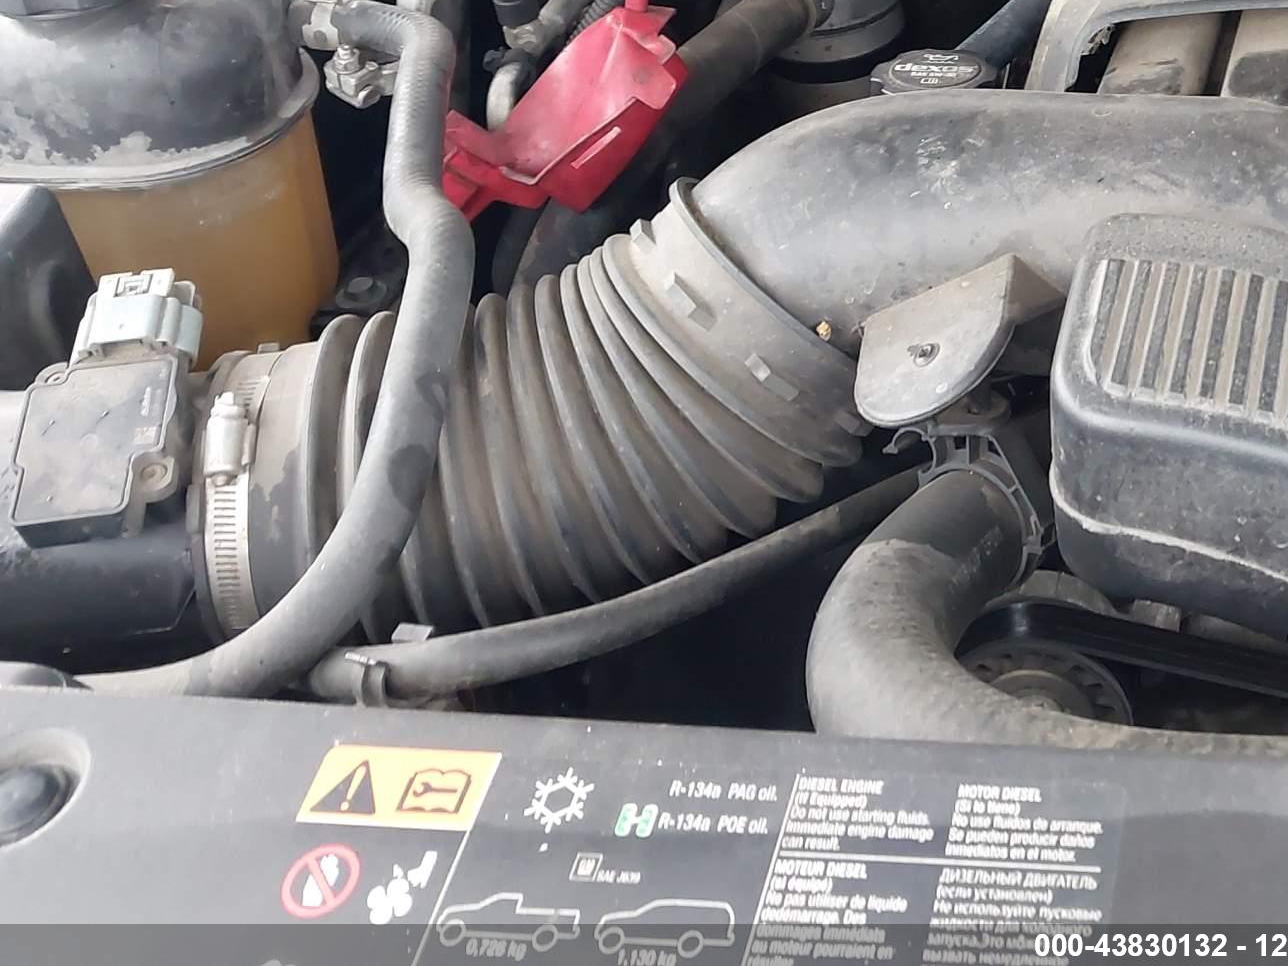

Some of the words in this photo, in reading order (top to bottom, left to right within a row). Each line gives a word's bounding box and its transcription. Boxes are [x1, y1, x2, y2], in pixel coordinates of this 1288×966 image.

[727, 782, 755, 801] PAG
[758, 785, 778, 801] oil.
[799, 777, 838, 792] DIESEL
[840, 779, 884, 795] ENGINE
[958, 784, 1001, 799] MOTOR
[1002, 786, 1042, 802] DIESEL
[717, 814, 747, 834] POE
[748, 817, 768, 834] oil.
[790, 805, 805, 820] Do
[808, 807, 827, 821] not
[829, 810, 850, 822] use
[851, 809, 895, 826] starting
[952, 813, 968, 828] No
[970, 816, 991, 829] use
[993, 815, 1031, 830] fluidos
[1033, 817, 1049, 832] de
[1050, 819, 1104, 835] arranque.
[786, 819, 845, 836] Immediate
[847, 824, 886, 840] engine
[888, 825, 934, 842] damage
[949, 827, 965, 842] Se
[966, 830, 1008, 845] pueden
[1010, 832, 1059, 847] producir
[781, 837, 802, 850] can
[804, 837, 840, 851] result.
[1010, 846, 1025, 860] en
[1027, 846, 1040, 861] el
[775, 859, 825, 876] MOTEUR
[826, 861, 867, 880] DIESEL
[938, 867, 1022, 885] ДИЗЕЛЬНЫЙ
[1023, 872, 1098, 890] ДВИГАТЕЛЬ
[765, 890, 783, 906] Ne
[784, 893, 806, 908] pas
[808, 894, 849, 909] utiliser
[850, 895, 866, 910] de
[867, 895, 908, 913] liquide
[936, 884, 971, 899] (если
[973, 887, 1053, 904] установлен)
[843, 910, 867, 925] Des
[933, 900, 952, 915] Не
[954, 902, 1036, 919] используйте
[1038, 905, 1103, 922] пусковые
[769, 940, 813, 956] moteur
